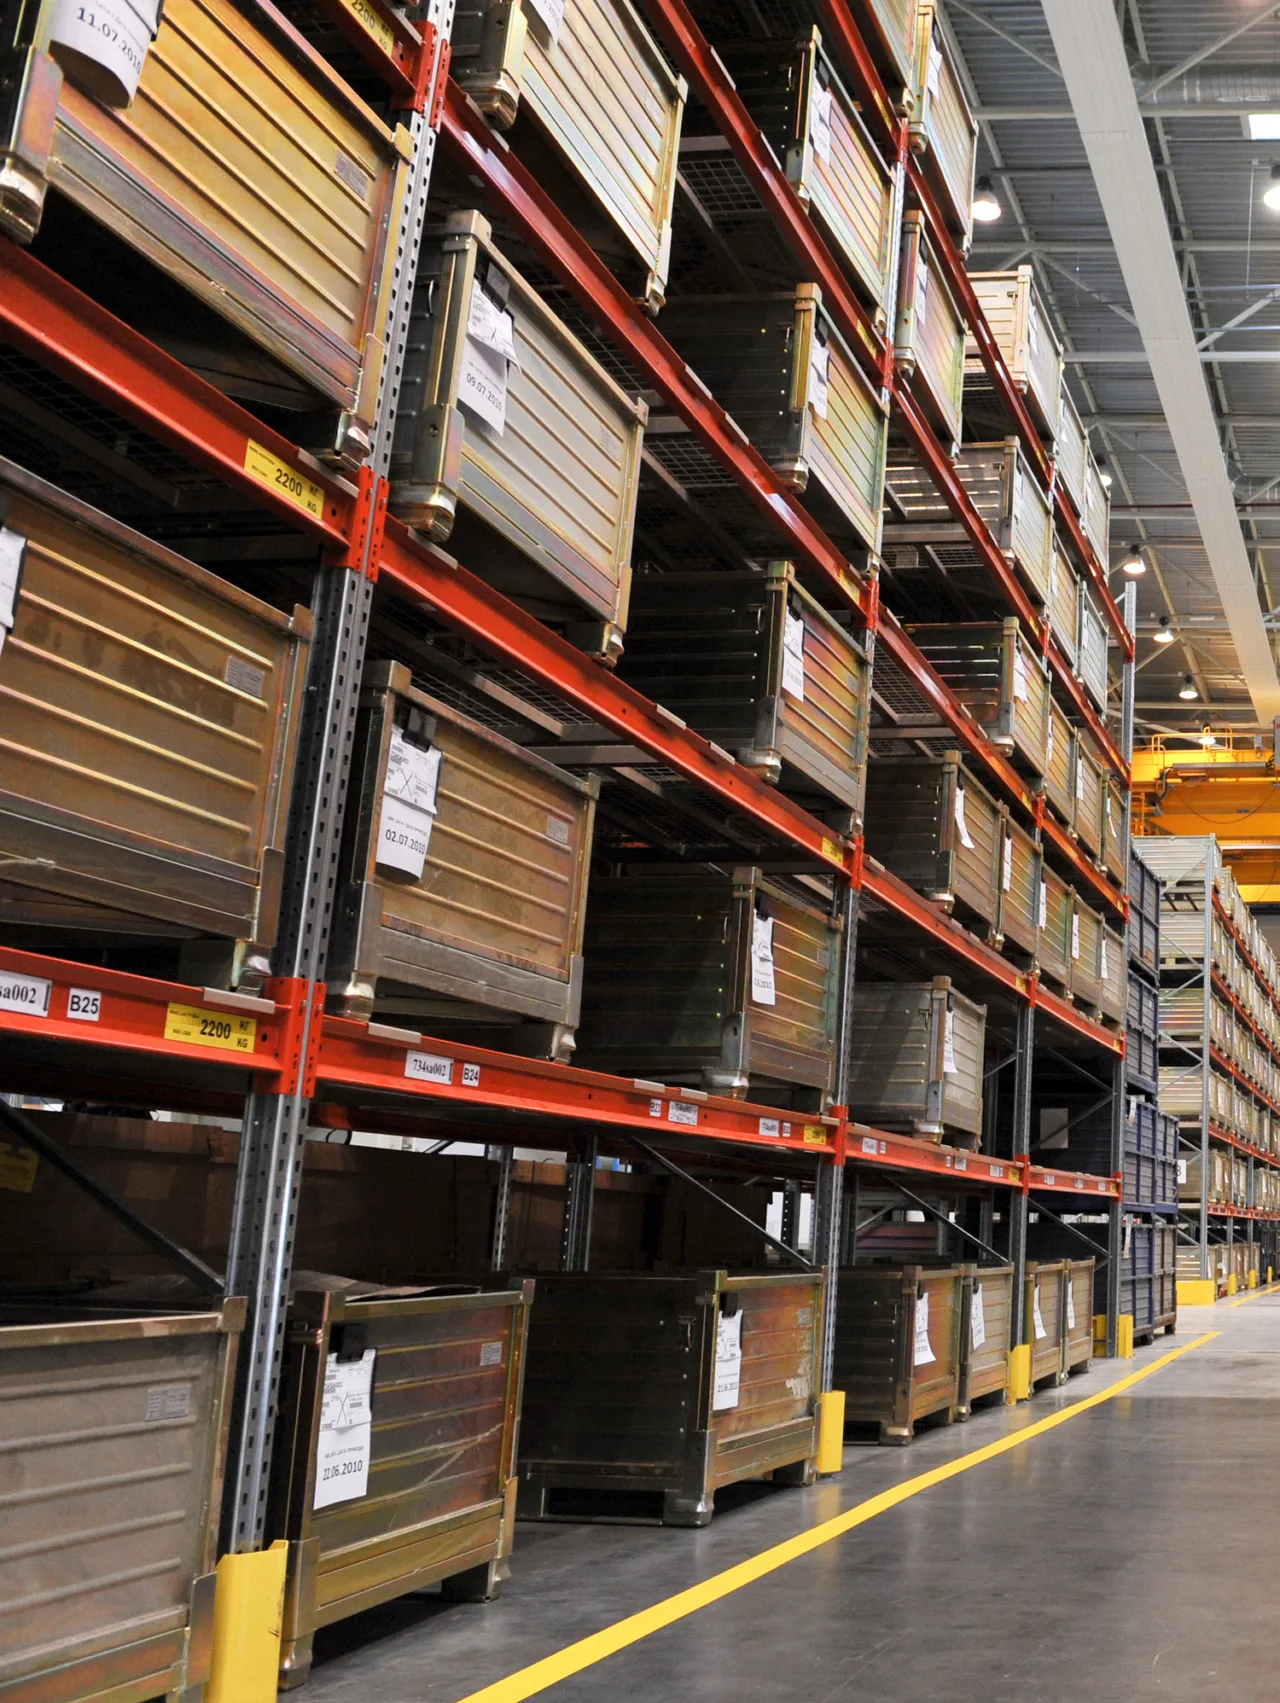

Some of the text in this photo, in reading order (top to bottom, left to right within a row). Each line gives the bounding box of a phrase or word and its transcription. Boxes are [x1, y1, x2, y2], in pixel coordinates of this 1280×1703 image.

[77, 7, 142, 75] 11.07.2010
[466, 373, 503, 412] 09.07.2010
[275, 468, 303, 497] 2200
[307, 500, 317, 513] KG
[385, 829, 425, 855] 02.07.2010
[70, 995, 99, 1014] B25
[200, 1019, 231, 1039] 2200
[237, 1038, 248, 1048] KG
[413, 1059, 446, 1076] 734sa002
[464, 1068, 479, 1082] B24
[323, 1460, 363, 1481] 22.06.2010
